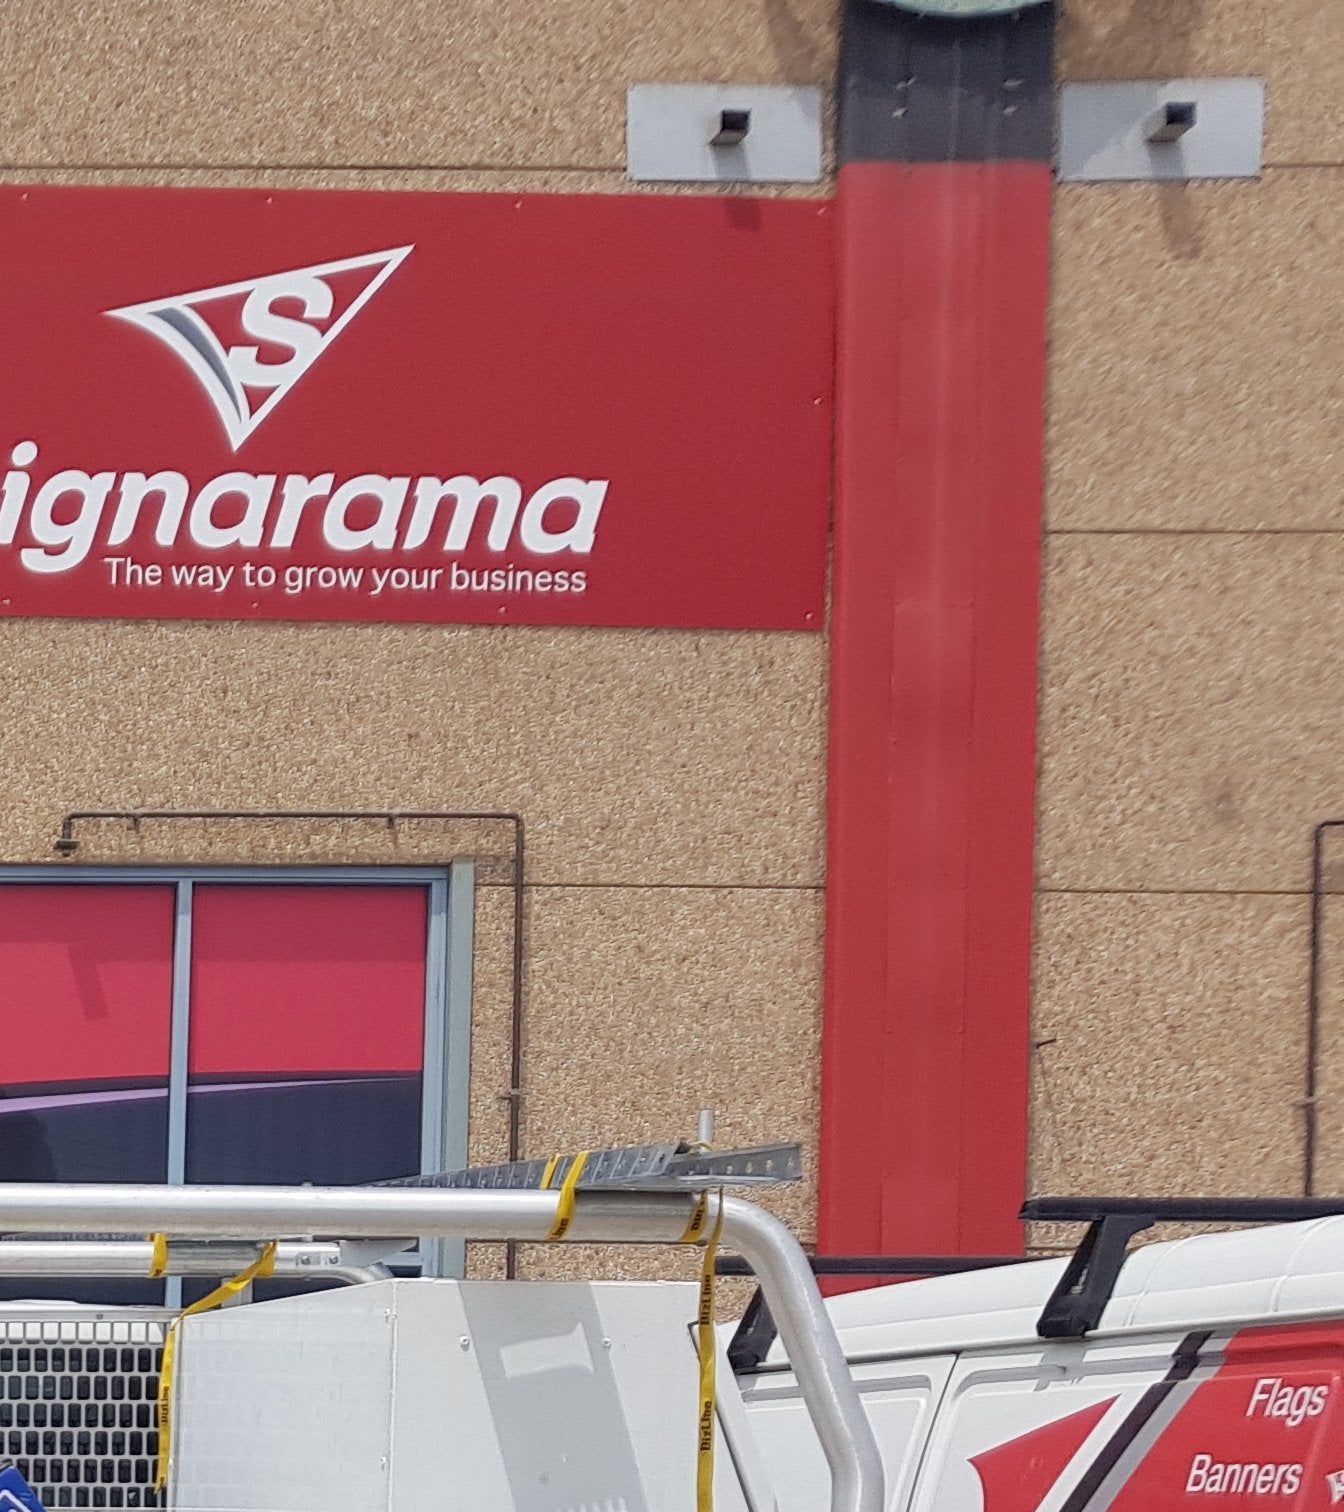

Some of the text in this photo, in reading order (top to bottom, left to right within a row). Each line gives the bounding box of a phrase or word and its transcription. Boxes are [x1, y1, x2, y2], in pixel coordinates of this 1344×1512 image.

[103, 557, 587, 597] The way to grow your business
[1245, 1377, 1329, 1428] Flags
[1185, 1453, 1303, 1495] Banners
